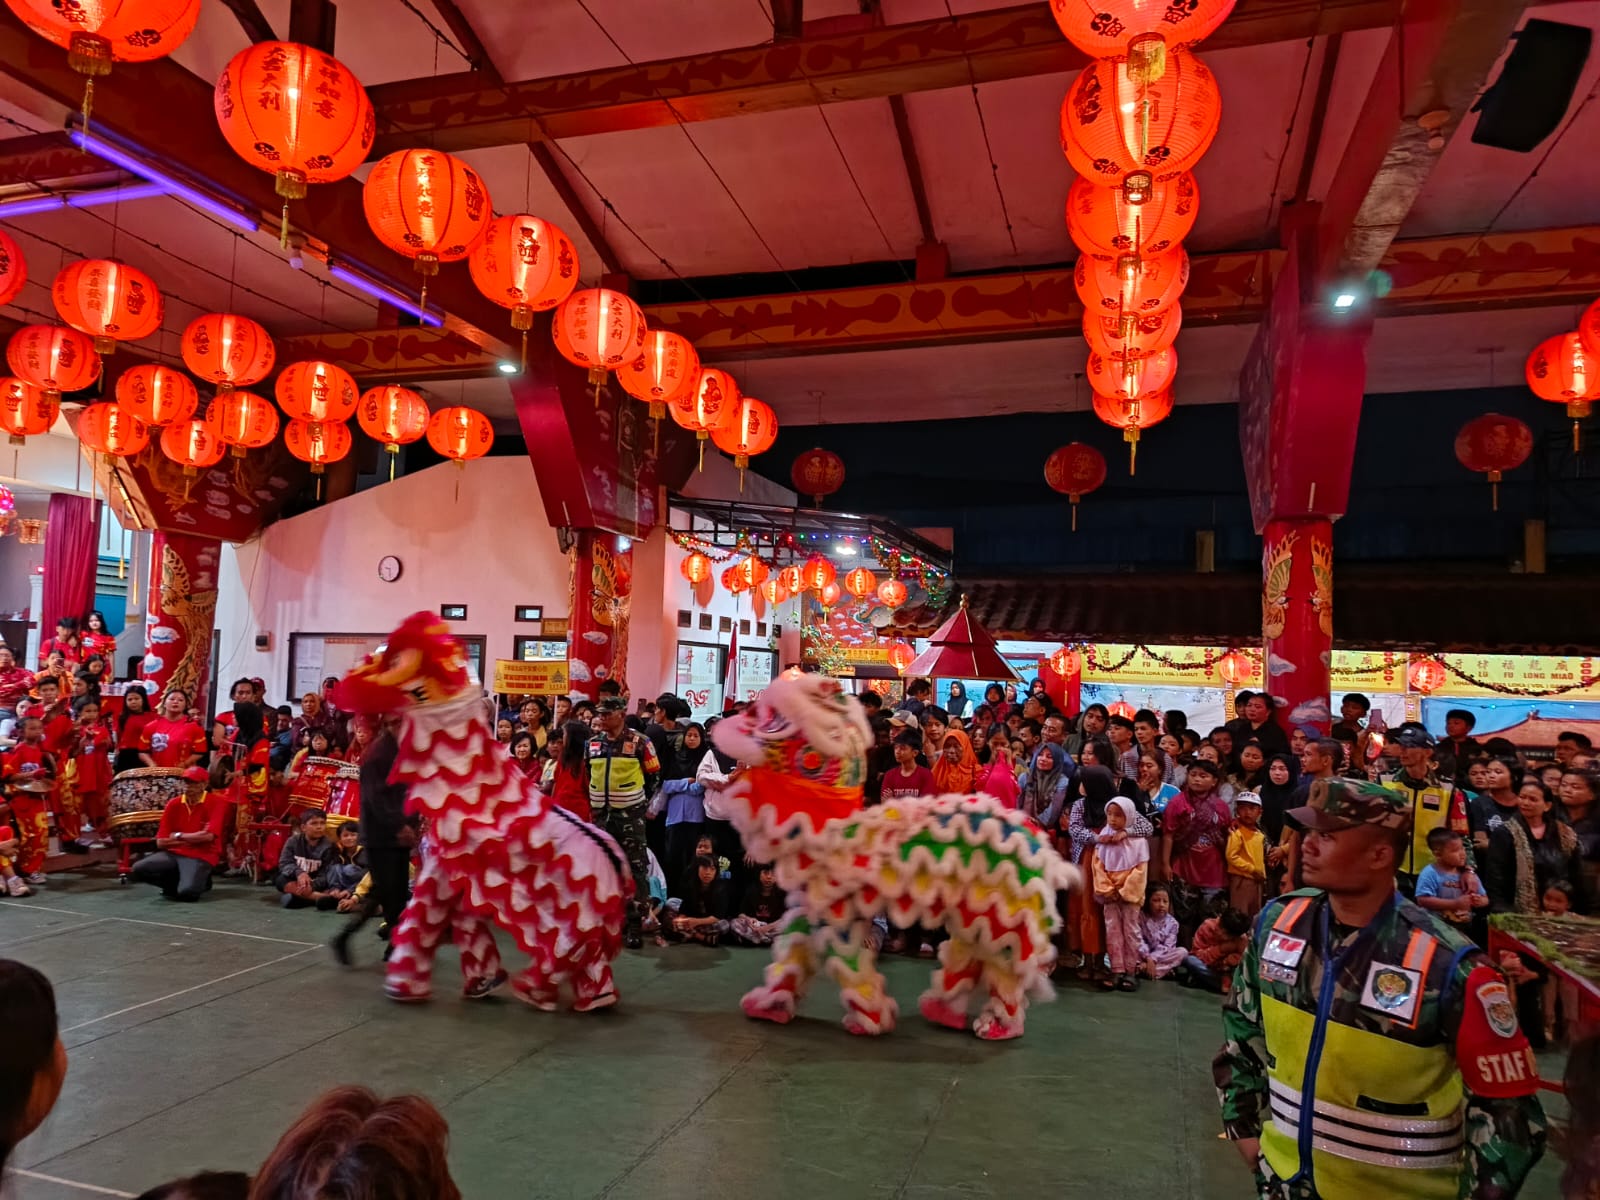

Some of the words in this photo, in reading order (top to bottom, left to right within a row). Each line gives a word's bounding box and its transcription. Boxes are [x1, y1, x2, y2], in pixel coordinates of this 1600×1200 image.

[259, 46, 286, 111] 大吉大利
[1550, 672, 1573, 680] MIAO
[1476, 1051, 1525, 1083] STAF
